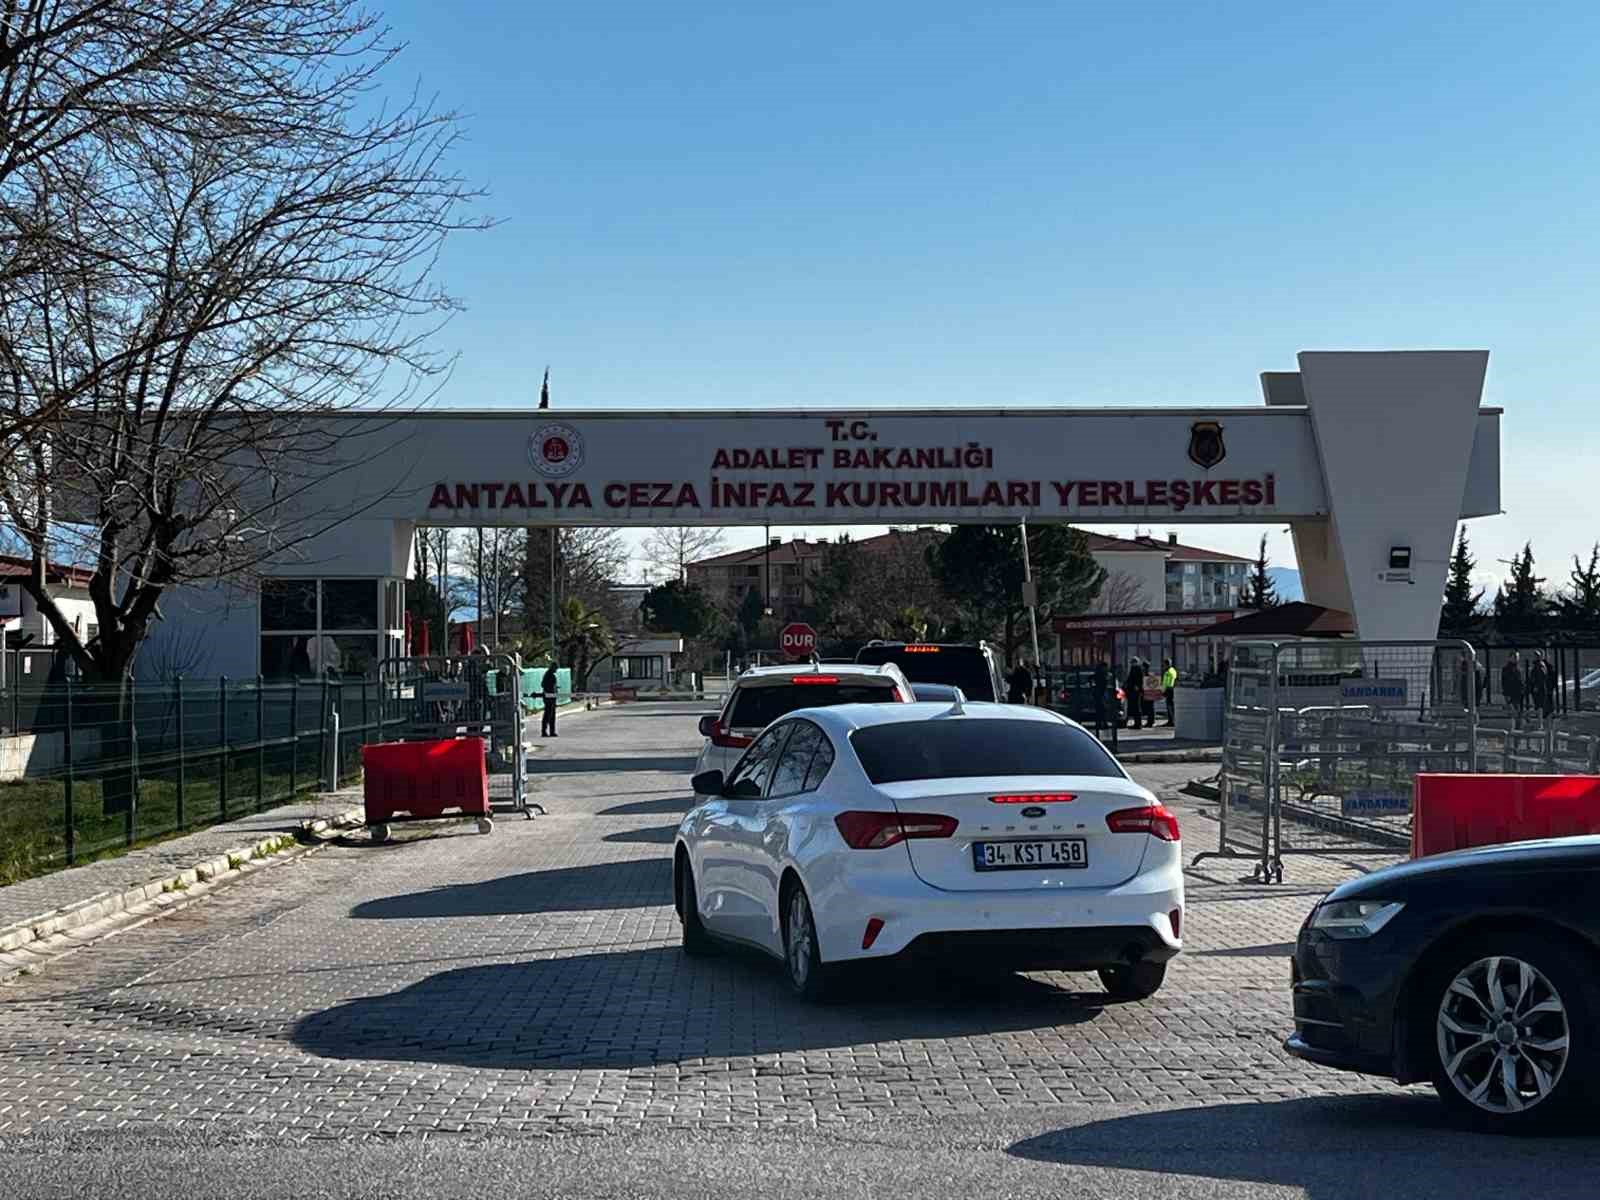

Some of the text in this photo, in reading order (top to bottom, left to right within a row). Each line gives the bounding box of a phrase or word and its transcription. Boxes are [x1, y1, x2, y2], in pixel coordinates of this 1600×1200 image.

[826, 420, 878, 440] T.C.
[711, 442, 993, 469] ADALET BAKANLIĞI
[429, 474, 1275, 511] ANTALYA CEZA İNFAZ KURUMLARI YERLEŞKESİ
[783, 634, 814, 647] DUR
[986, 842, 1081, 863] 34 KST 458
